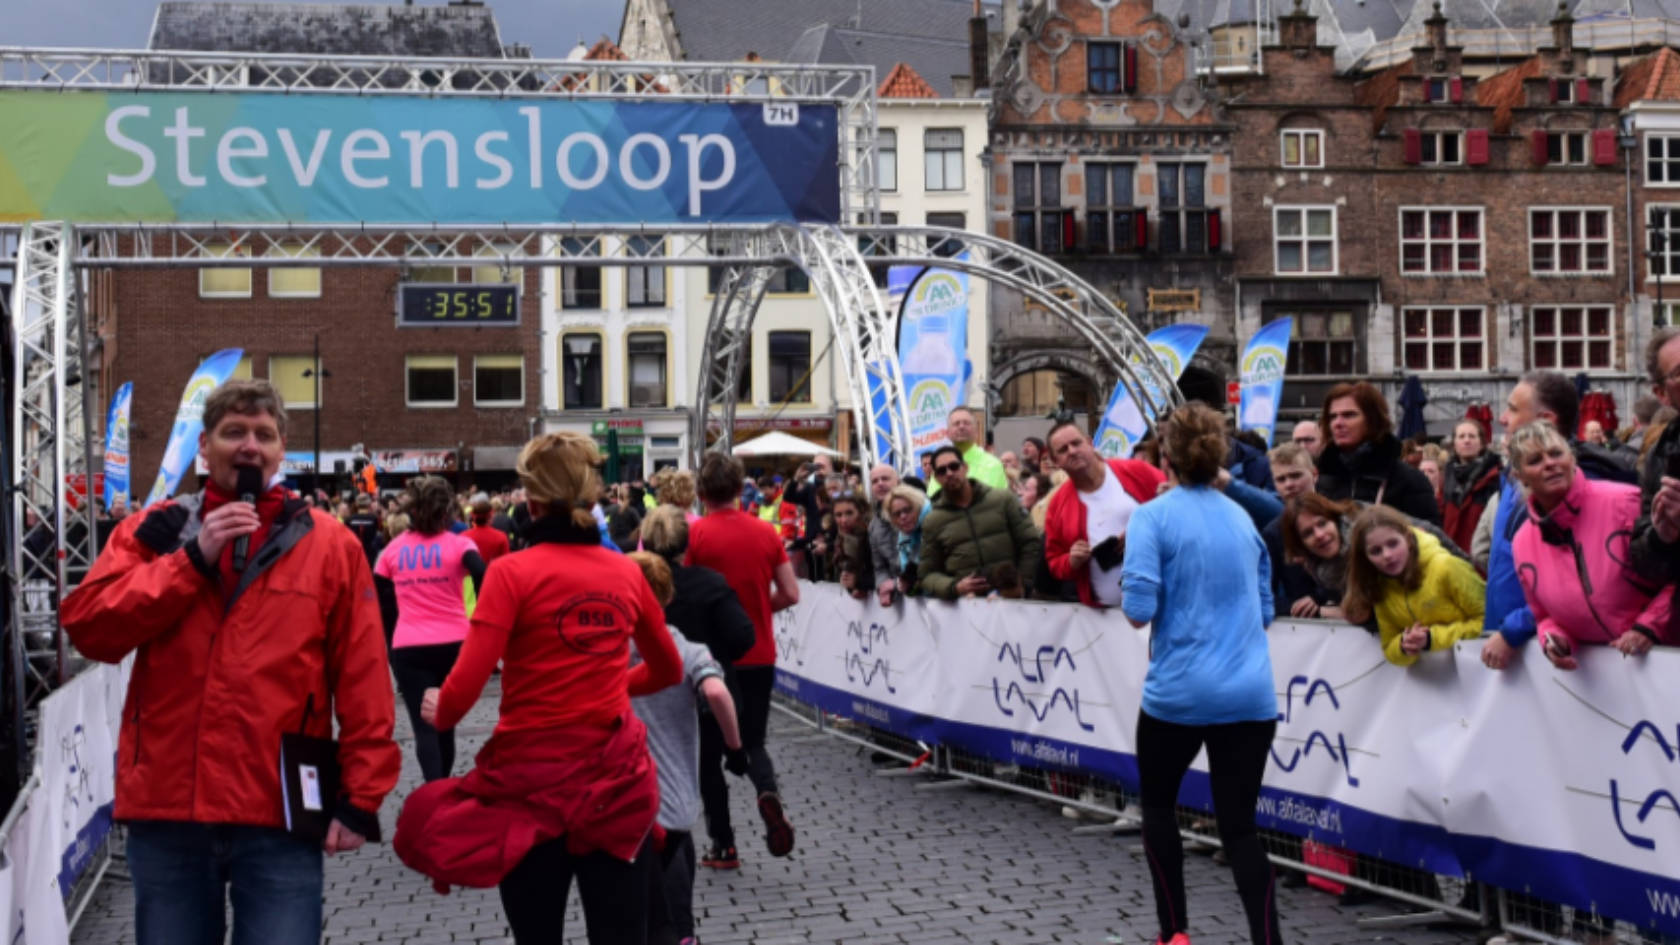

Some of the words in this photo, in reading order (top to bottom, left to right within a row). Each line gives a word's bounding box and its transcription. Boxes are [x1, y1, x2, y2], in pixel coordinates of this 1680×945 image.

[768, 107, 794, 121] 7H
[105, 104, 738, 217] Stevensloop
[579, 611, 614, 627] BSB
[998, 642, 1076, 684] ALFA
[993, 677, 1095, 733] LAVAL
